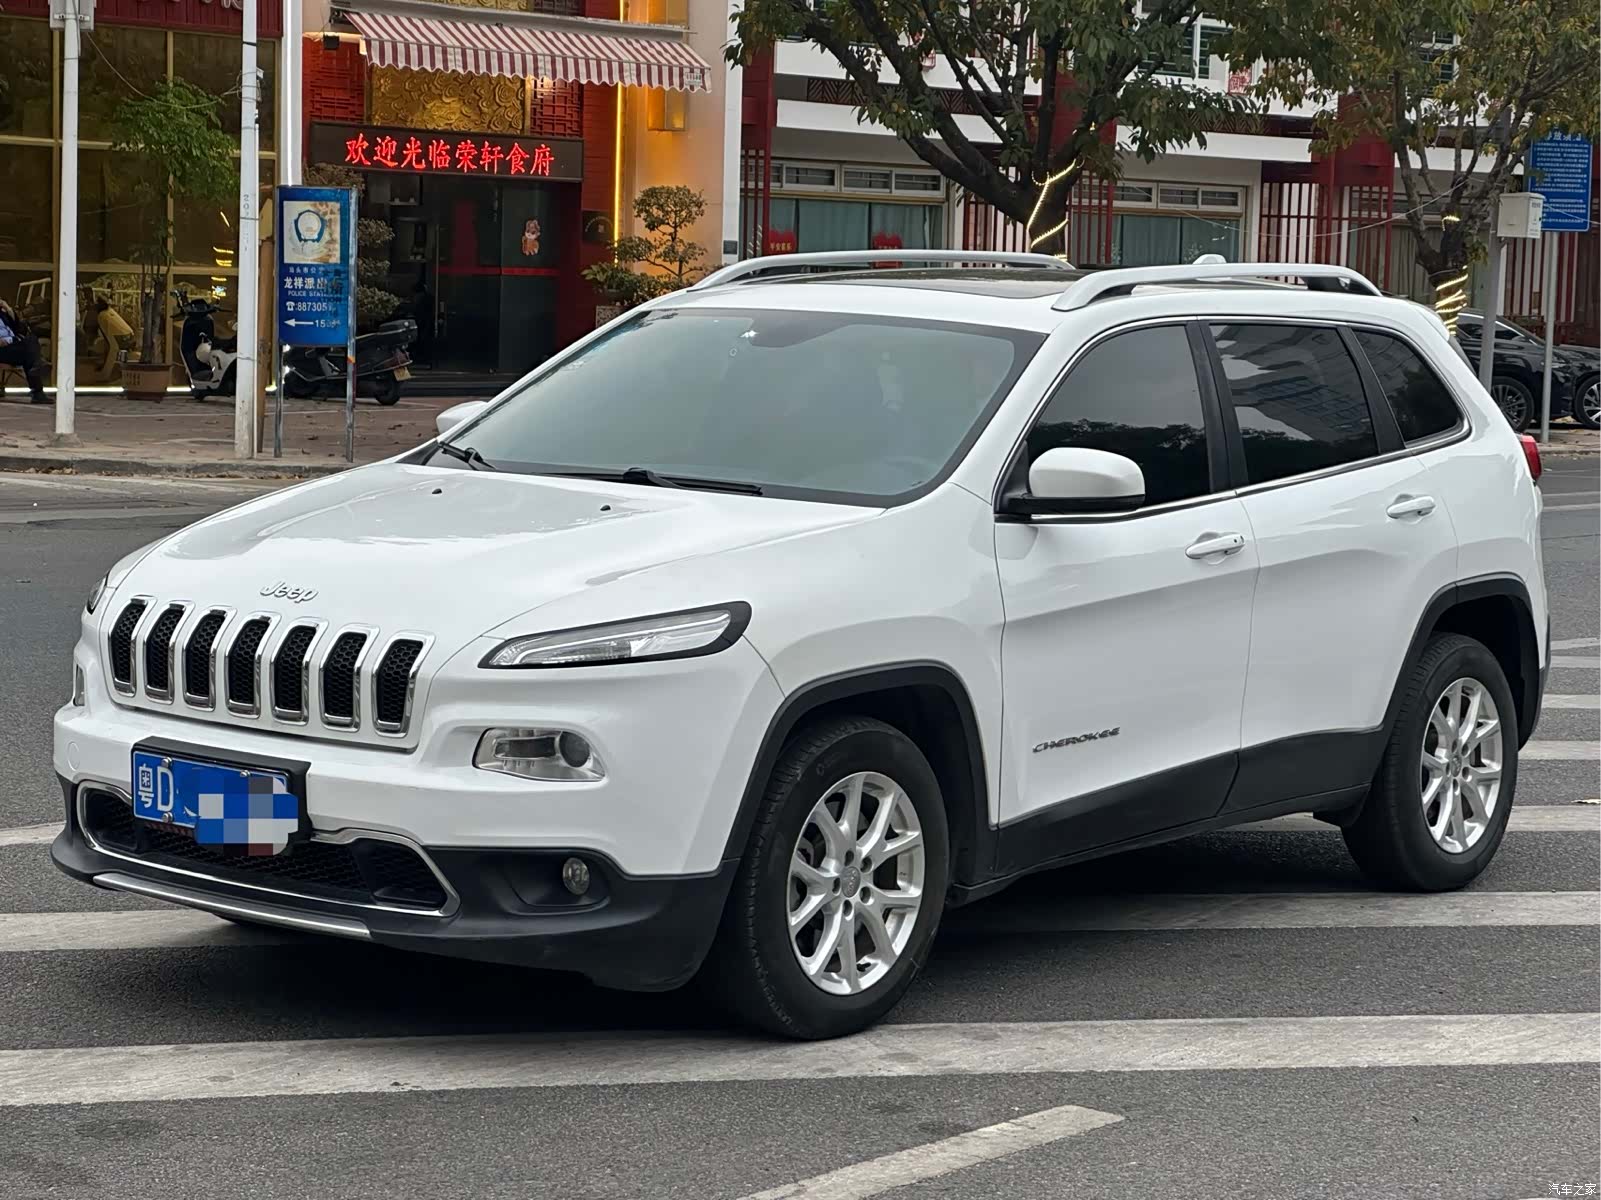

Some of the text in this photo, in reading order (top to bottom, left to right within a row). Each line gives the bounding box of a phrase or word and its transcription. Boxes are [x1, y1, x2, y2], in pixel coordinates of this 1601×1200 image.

[344, 132, 555, 177] 欢迎光临荣轩食府
[284, 276, 342, 291] 龙祥派出
[259, 580, 319, 604] Jeep
[1032, 727, 1121, 753] CHEROKEE
